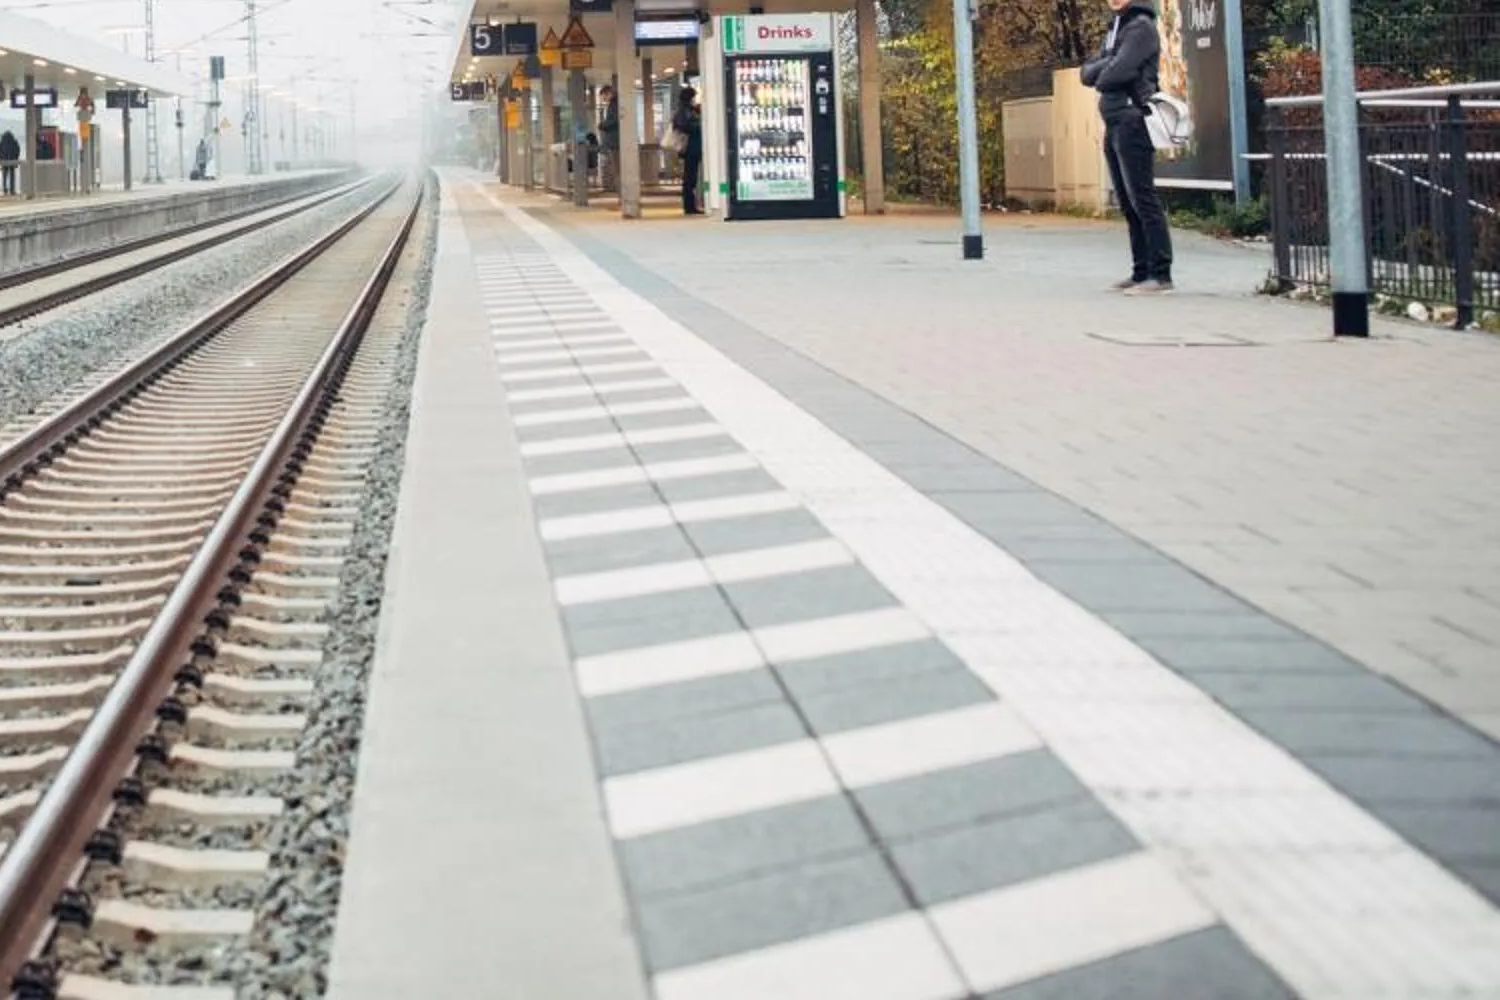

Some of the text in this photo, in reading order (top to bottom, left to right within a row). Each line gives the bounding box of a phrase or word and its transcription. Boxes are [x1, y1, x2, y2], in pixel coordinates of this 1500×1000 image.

[474, 25, 491, 49] 5
[757, 24, 814, 39] Drinks
[453, 83, 463, 99] 5
